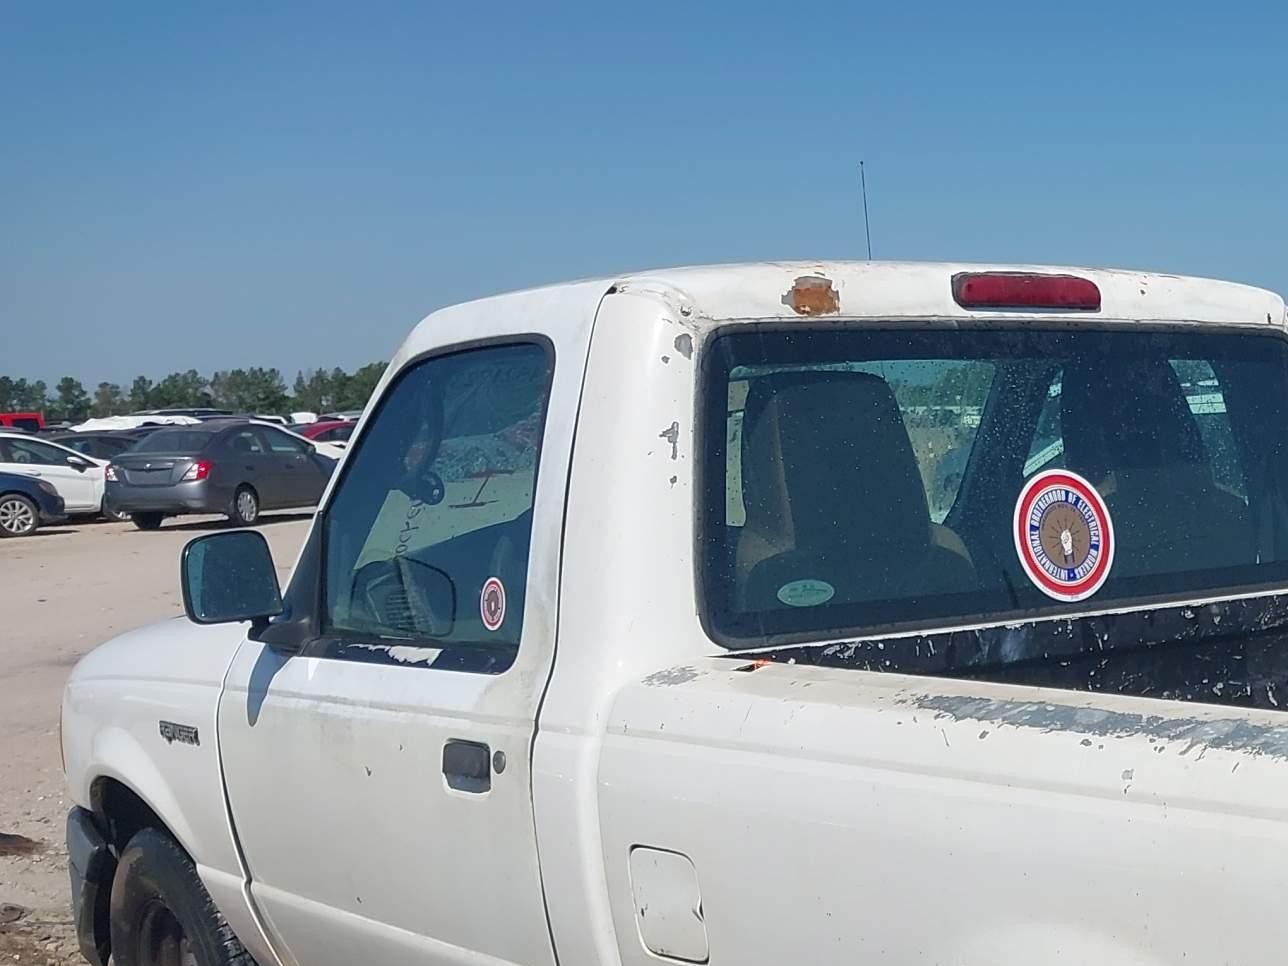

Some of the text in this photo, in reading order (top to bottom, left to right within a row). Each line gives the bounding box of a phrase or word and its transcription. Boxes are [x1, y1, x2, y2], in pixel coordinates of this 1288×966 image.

[1031, 489, 1066, 527] BROTHERHOOD
[1067, 491, 1078, 505] OF
[1077, 498, 1100, 545] ELECTRICAL
[1030, 530, 1069, 580] INTERNATIONAL
[1070, 548, 1099, 580] WORKERS
